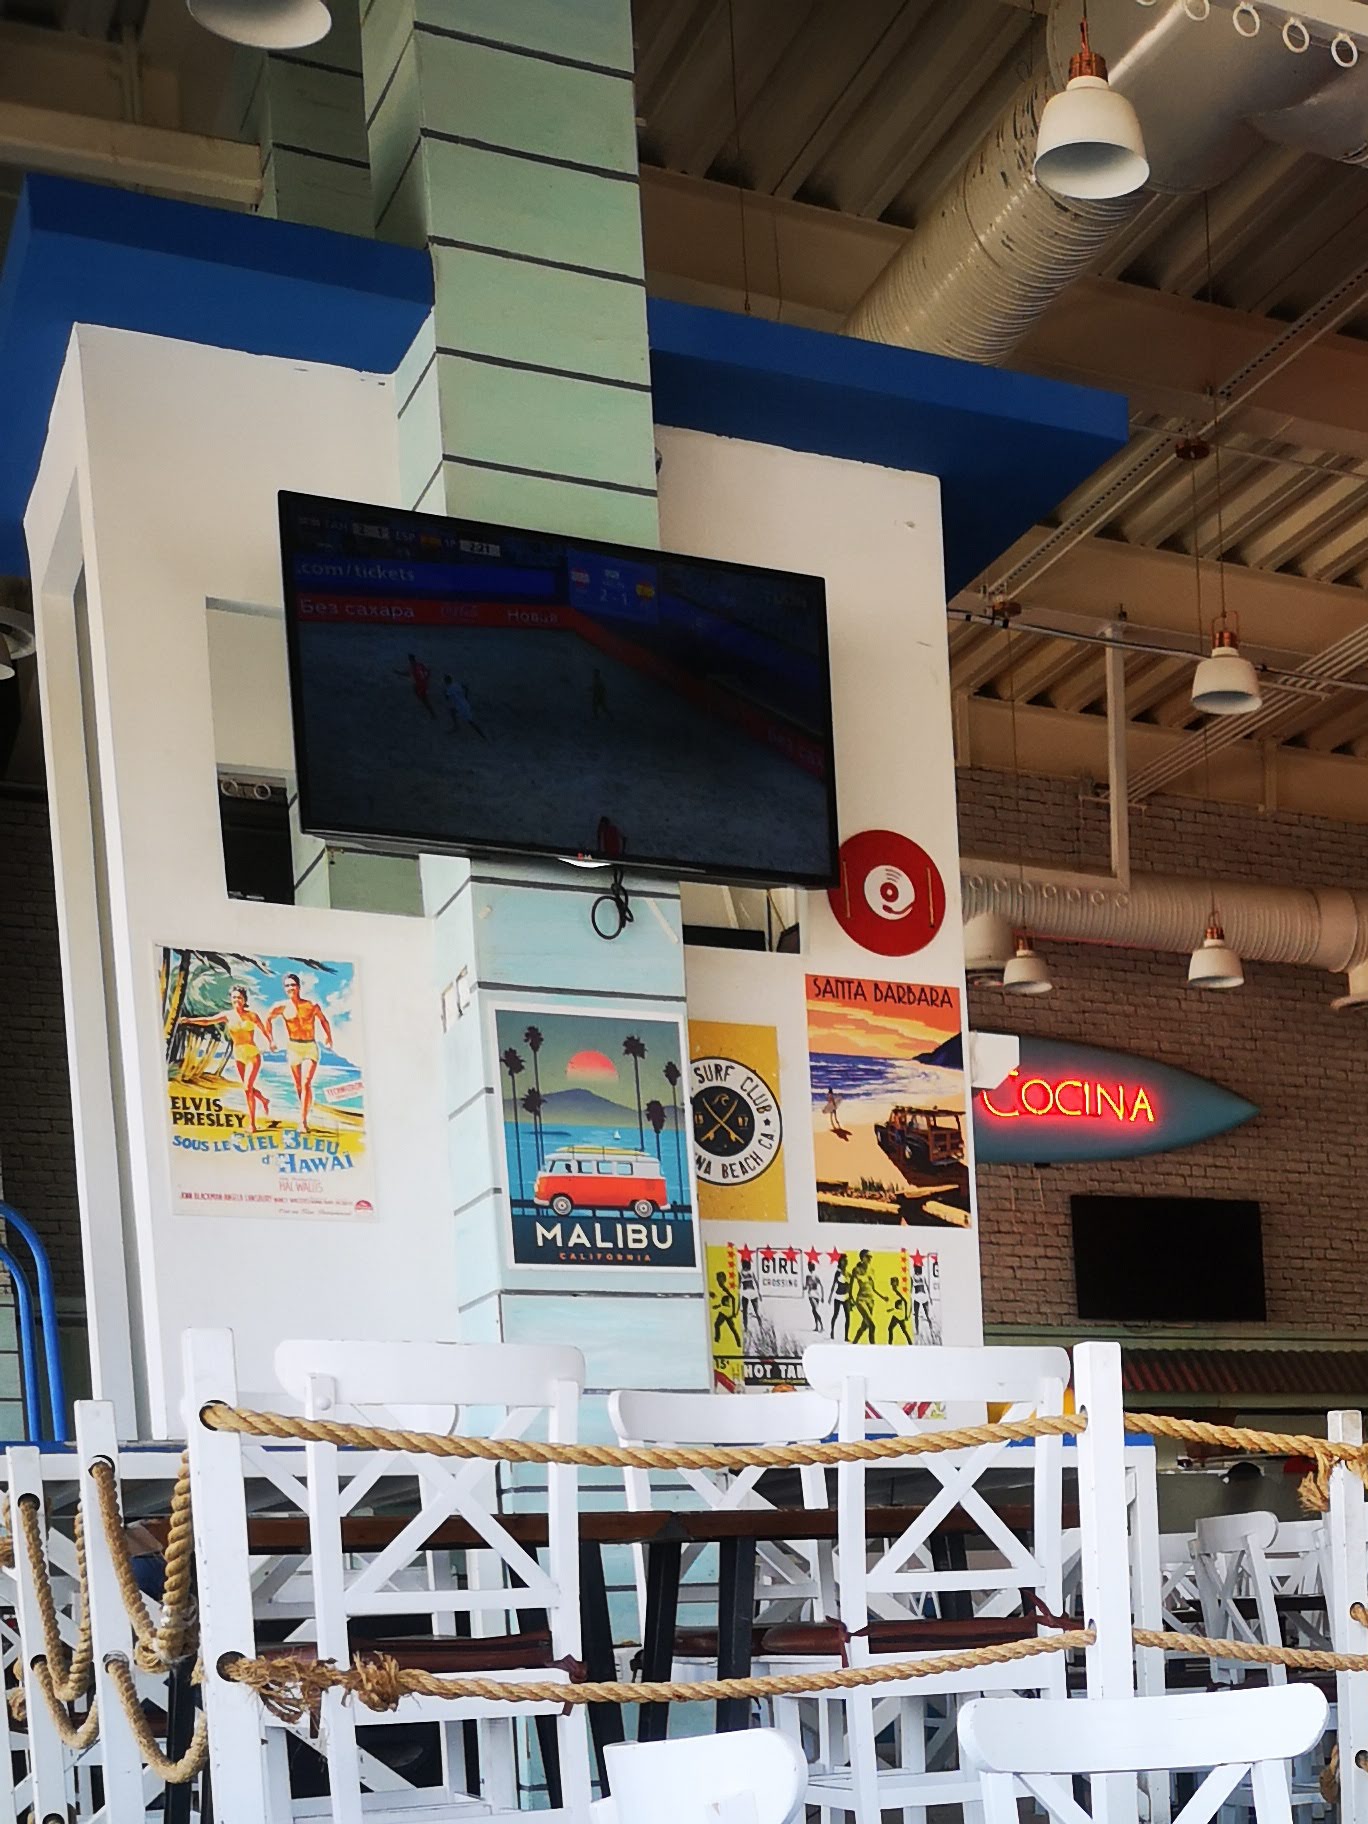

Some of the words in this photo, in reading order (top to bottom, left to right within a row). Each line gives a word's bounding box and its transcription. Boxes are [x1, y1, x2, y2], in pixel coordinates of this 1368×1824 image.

[345, 603, 415, 619] сахара
[813, 977, 867, 1002] SANTA
[873, 982, 953, 1009] BARBARA
[693, 1063, 735, 1085] SURF
[740, 1076, 772, 1115] CLUB
[982, 1070, 1155, 1122] COCINA
[169, 1096, 223, 1113] ELVIS
[172, 1111, 246, 1128] PRESLEY
[172, 1135, 210, 1152] SOUS
[214, 1138, 231, 1152] LE
[231, 1130, 279, 1153] CIEL
[282, 1129, 340, 1155] BLEU
[721, 1150, 764, 1179] BEACH
[758, 1131, 775, 1150] CA
[535, 1221, 673, 1250] MALIBU
[559, 1252, 651, 1262] CALIFORNIA
[761, 1257, 799, 1275] GIRL
[762, 1278, 798, 1288] CROSSING
[743, 1364, 773, 1379] HOT
